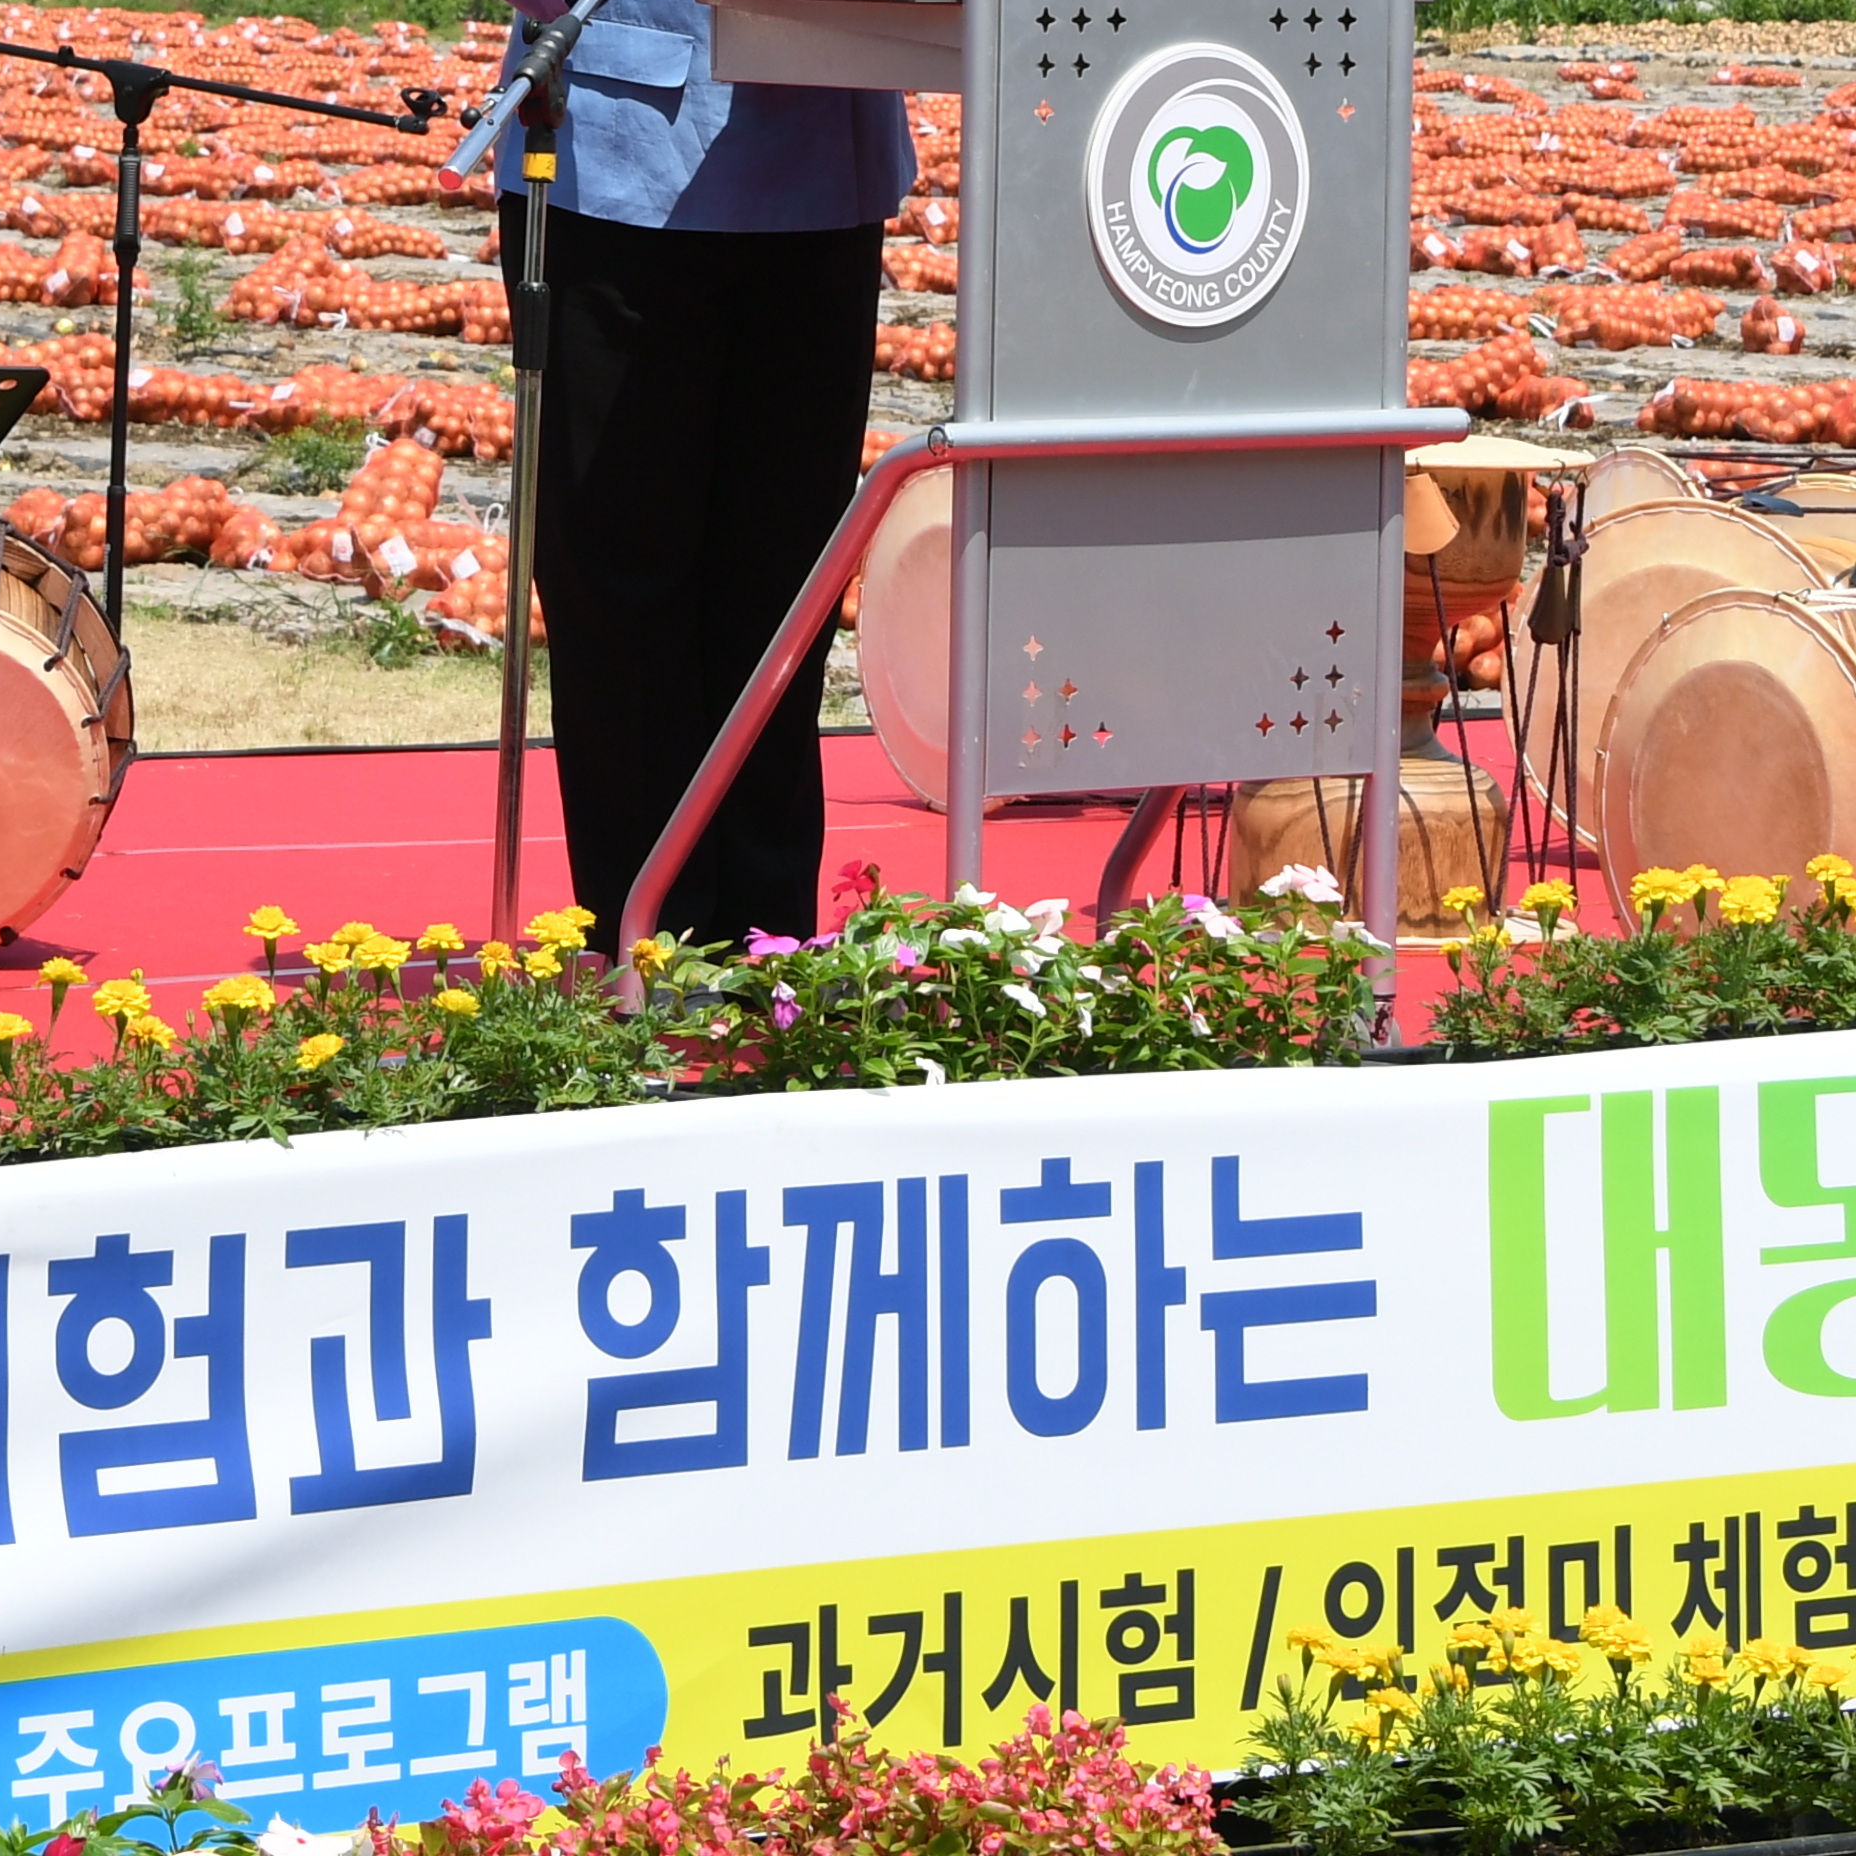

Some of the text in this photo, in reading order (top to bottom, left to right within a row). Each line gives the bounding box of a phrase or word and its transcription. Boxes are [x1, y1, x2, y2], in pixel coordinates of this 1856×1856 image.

[1106, 198, 1293, 308] HAMPYEONG COUNTY
[569, 1155, 1378, 1482] 함께하는
[744, 1568, 1195, 1747] 과거시험
[1323, 1524, 1632, 1701] 인절미
[11, 1648, 588, 1828] 주요프로그램
